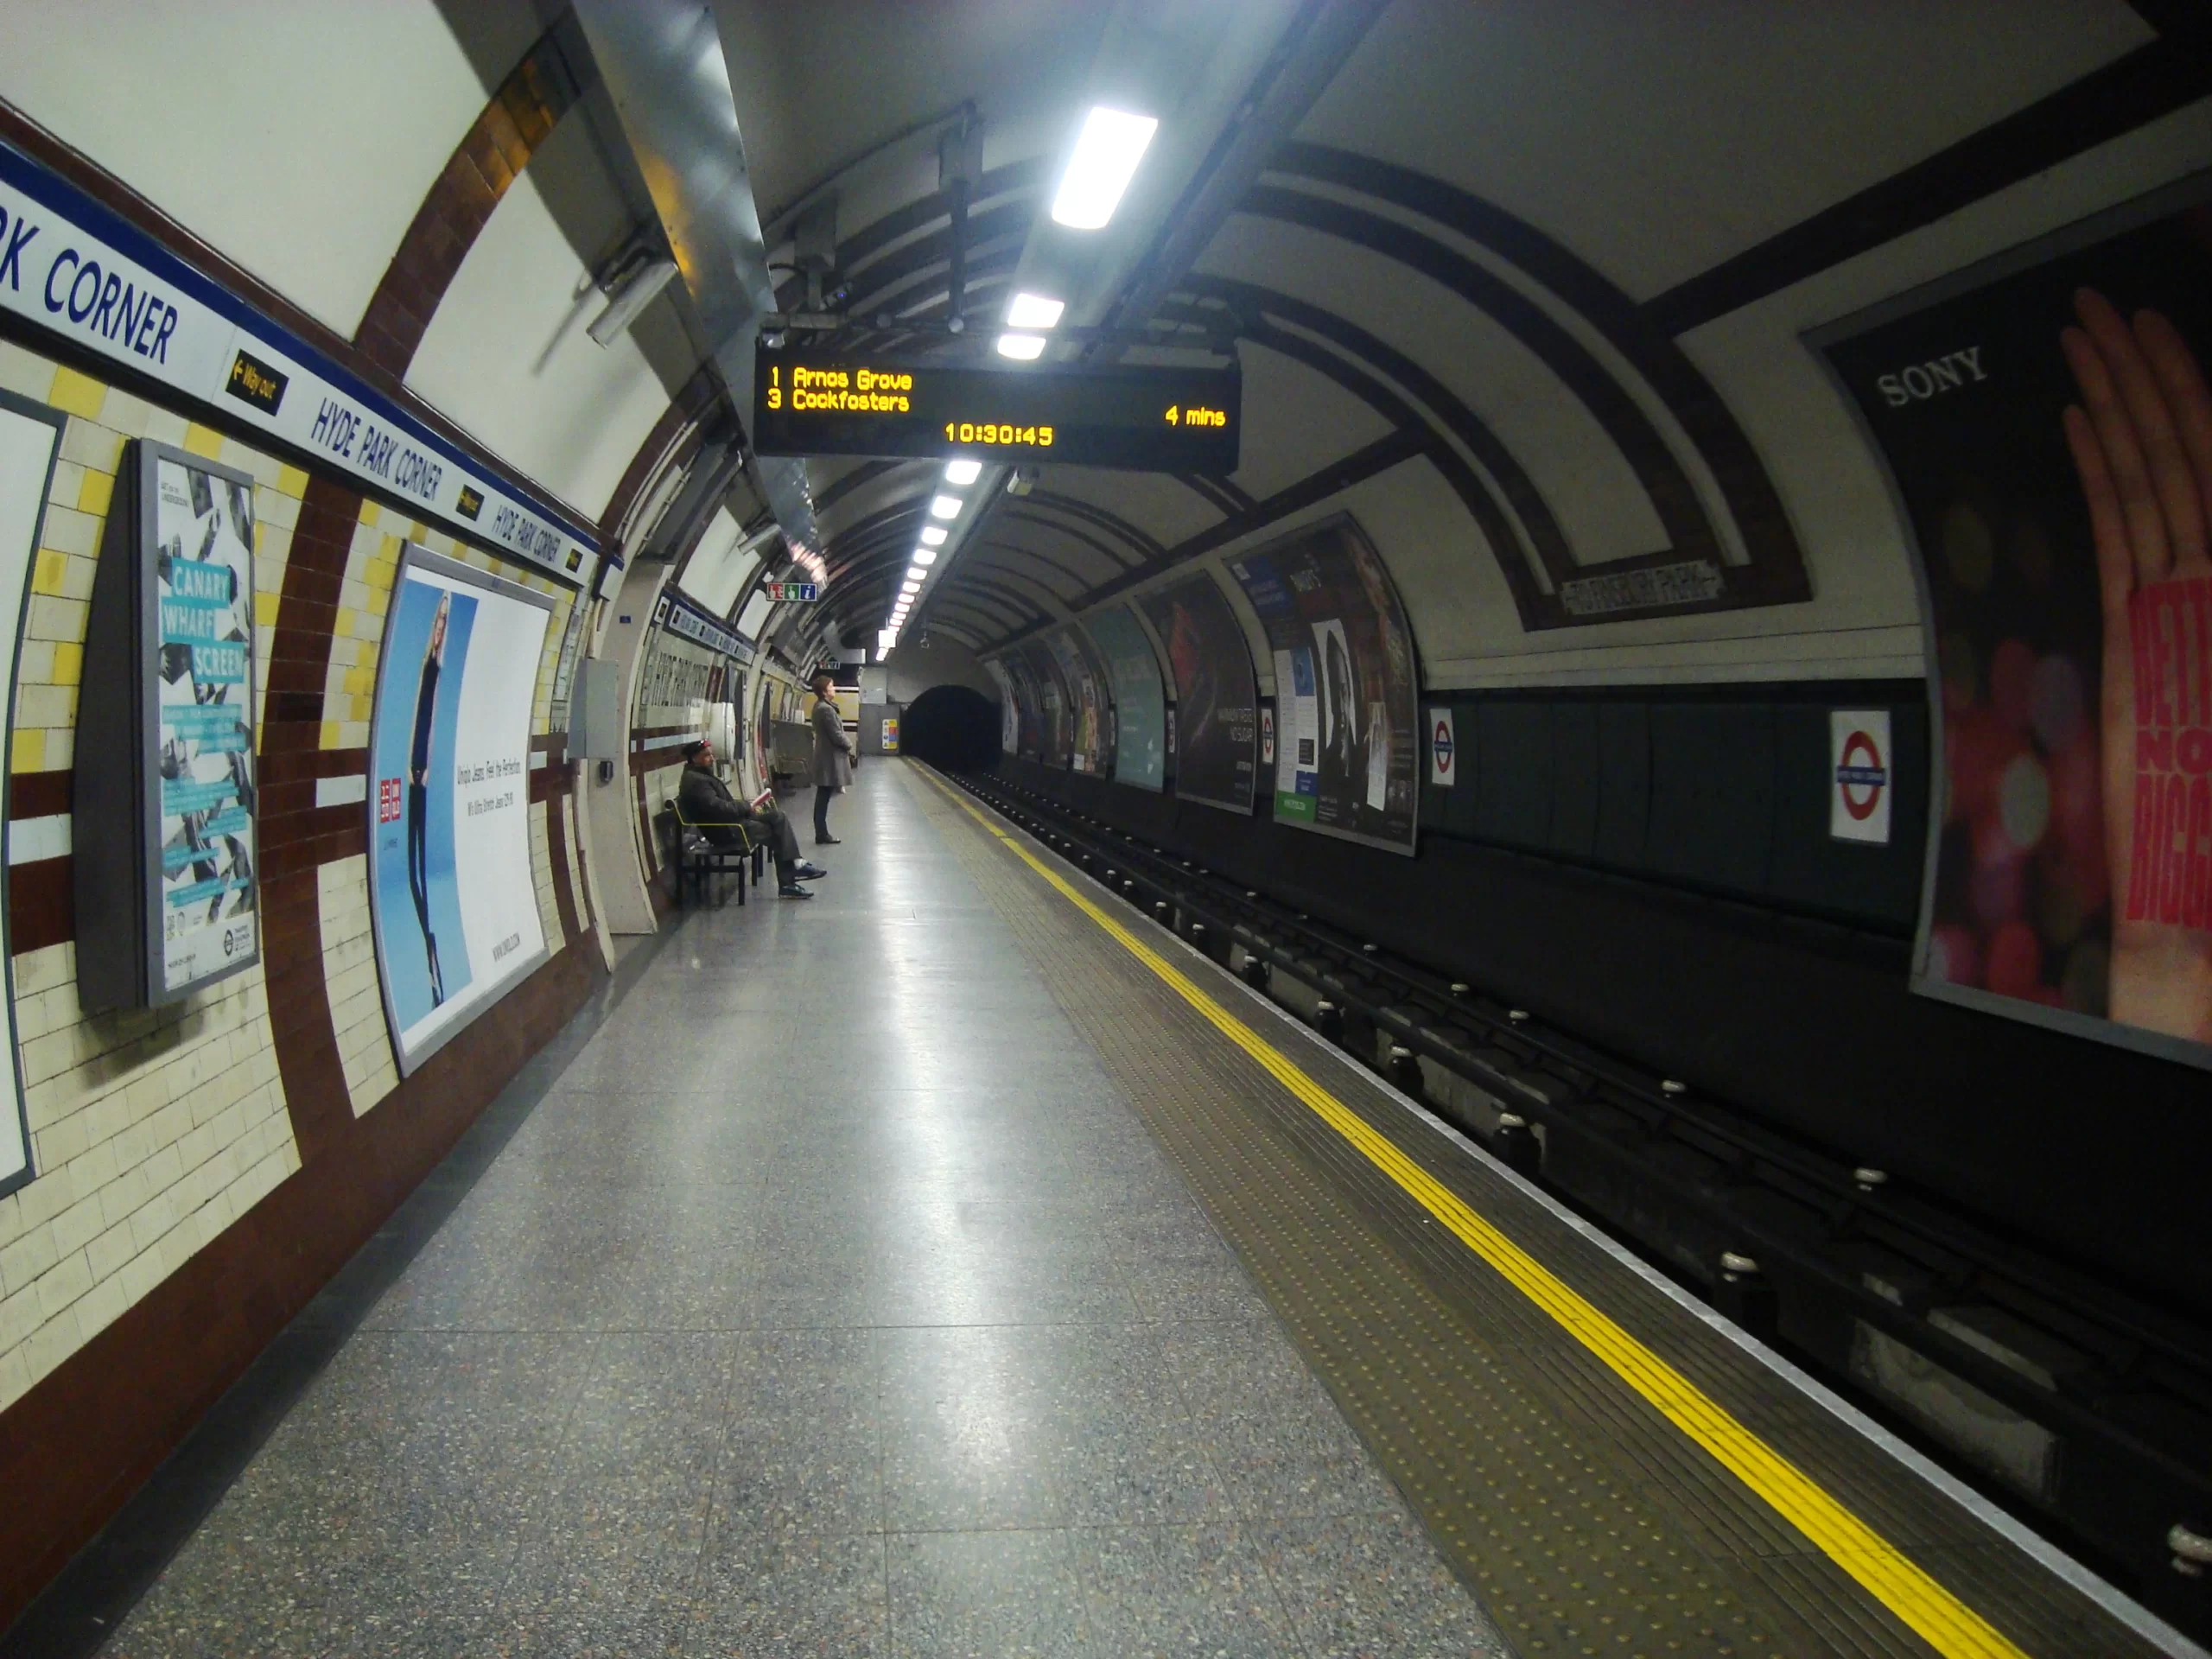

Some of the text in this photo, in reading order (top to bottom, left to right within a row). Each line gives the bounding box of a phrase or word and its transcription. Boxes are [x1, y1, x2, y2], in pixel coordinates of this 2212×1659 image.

[44, 248, 178, 365] CORNER
[772, 366, 912, 391] 1 Arnos Grove
[1877, 346, 1988, 407] SONY
[767, 389, 910, 412] 3 Cockfosters
[1165, 405, 1226, 428] 4 mins
[311, 397, 361, 458] HYDE
[357, 425, 398, 479] PARK
[395, 448, 442, 501] CORNER
[945, 423, 1053, 447] 10:30:45
[174, 566, 229, 602] CANARY
[163, 605, 214, 639] WHARF
[194, 646, 243, 676] SCREEN
[2126, 773, 2212, 933] BIGG
